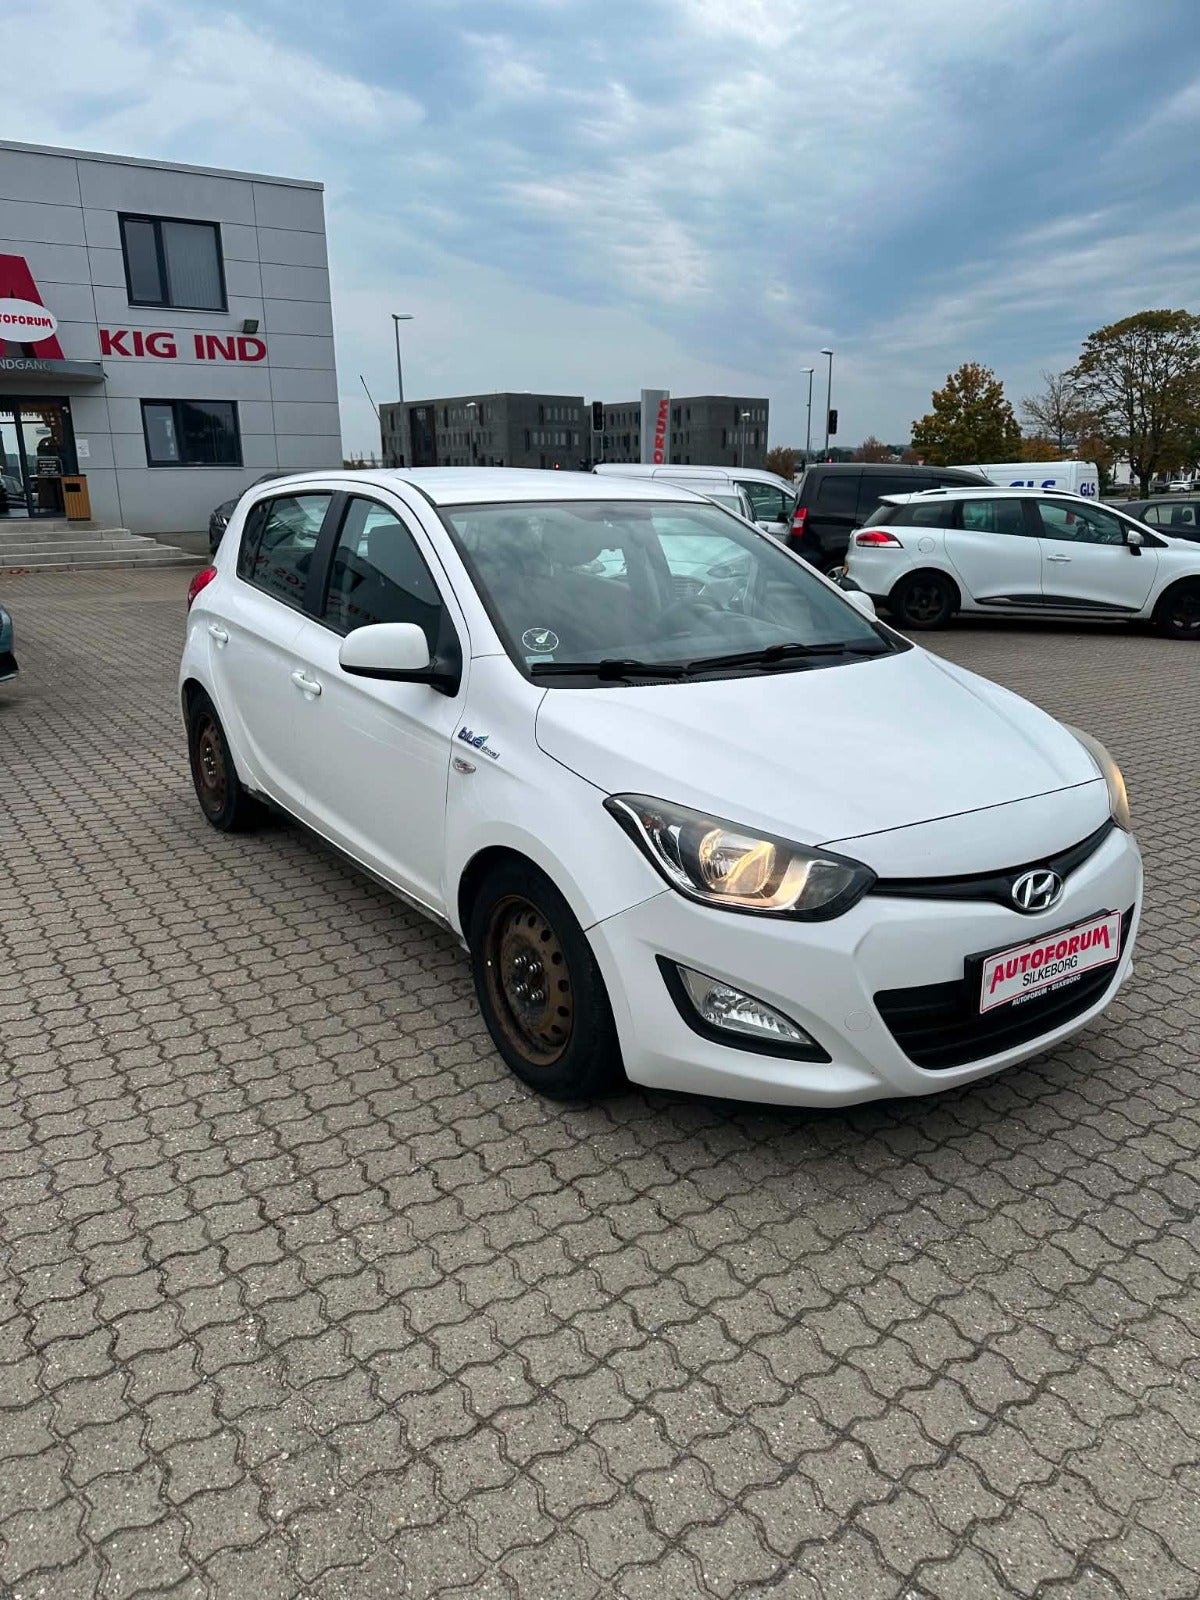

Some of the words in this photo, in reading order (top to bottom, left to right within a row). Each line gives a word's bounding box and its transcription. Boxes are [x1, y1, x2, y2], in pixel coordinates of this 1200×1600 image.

[99, 329, 177, 359] KIG
[194, 334, 267, 362] IND
[1080, 482, 1095, 497] GLS
[989, 924, 1110, 994] AUTOFORUM
[1022, 955, 1078, 987] SILKEBORG
[1011, 987, 1048, 1007] AUTOFORUM
[1051, 974, 1081, 991] SILKEBORG
